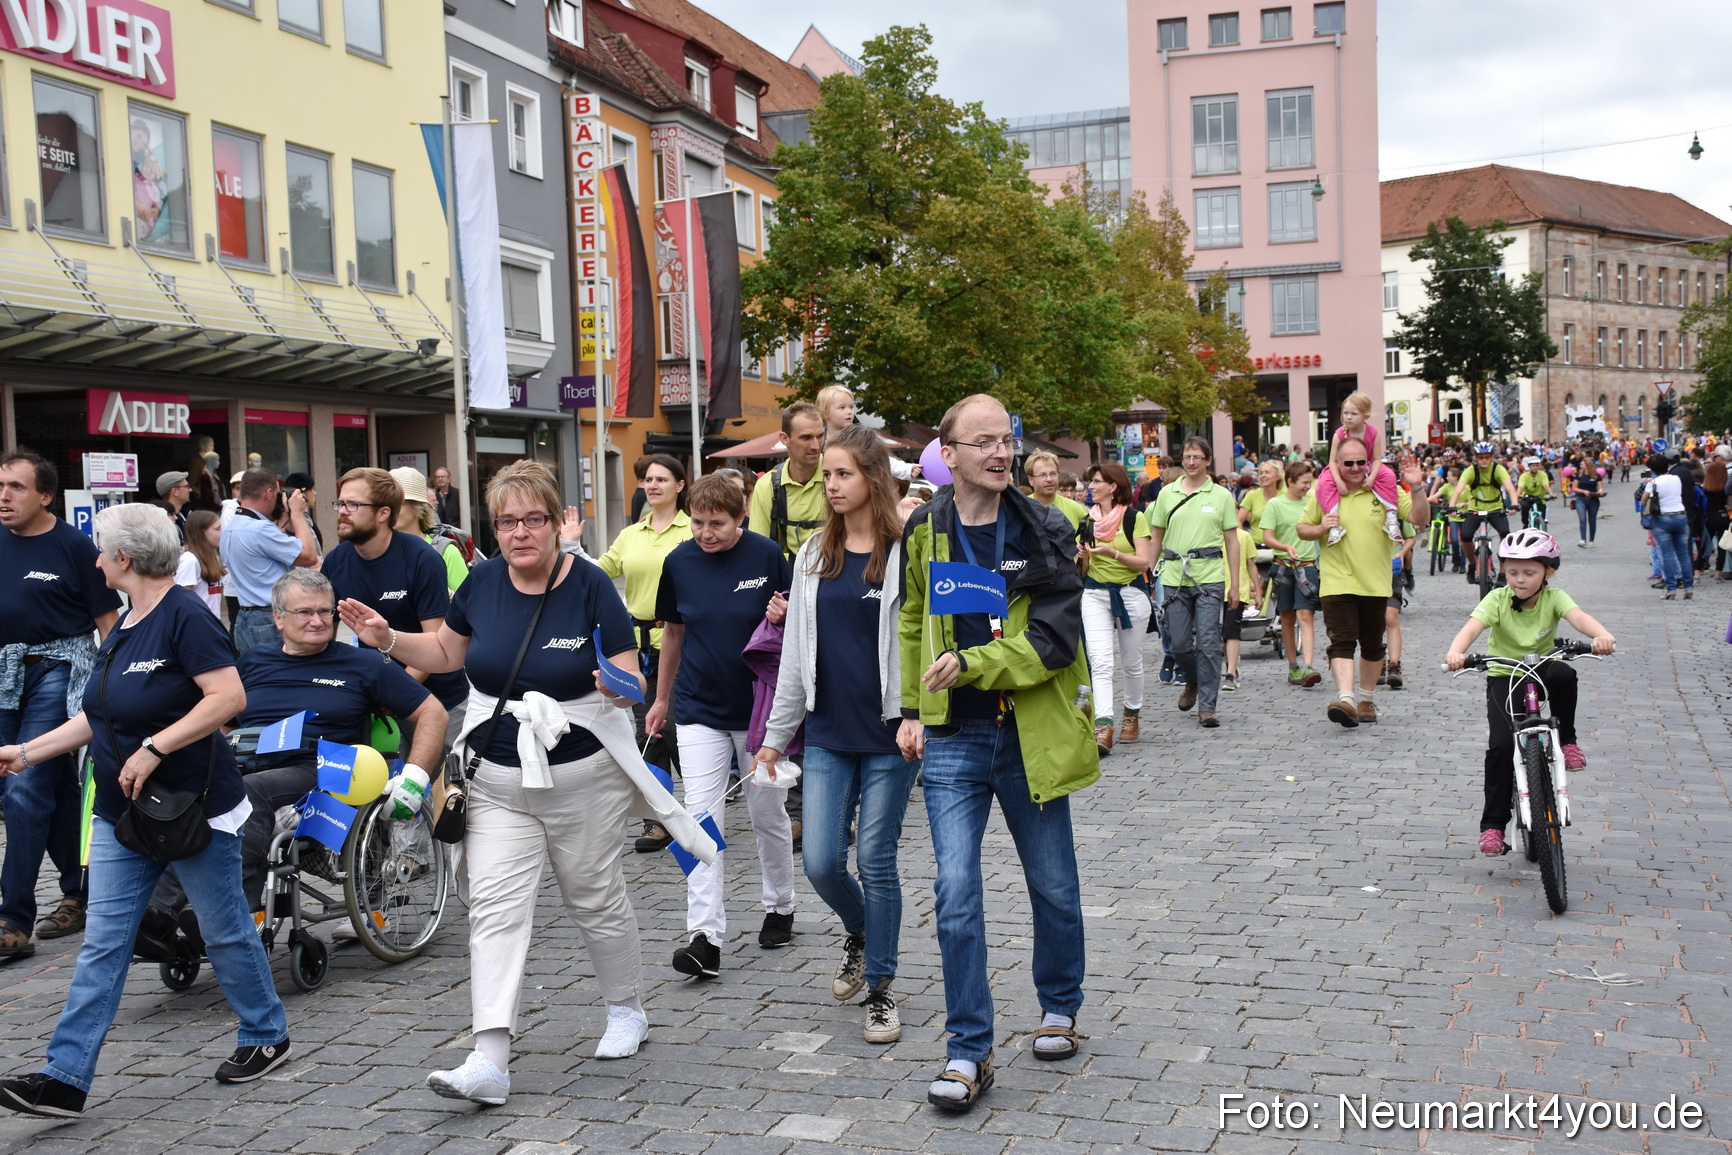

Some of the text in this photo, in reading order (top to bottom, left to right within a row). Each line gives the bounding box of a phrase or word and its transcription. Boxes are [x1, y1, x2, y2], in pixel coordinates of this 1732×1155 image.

[49, 147, 76, 166] SEITE
[575, 97, 595, 304] BÄCKEREI
[564, 384, 597, 399] libert
[99, 391, 191, 434] ADLER
[1012, 416, 1019, 435] P
[77, 511, 89, 530] P
[957, 581, 1004, 598] Lebenshilfe
[325, 760, 352, 772] Lebenshilfe
[316, 809, 348, 831] Lebenshilfe
